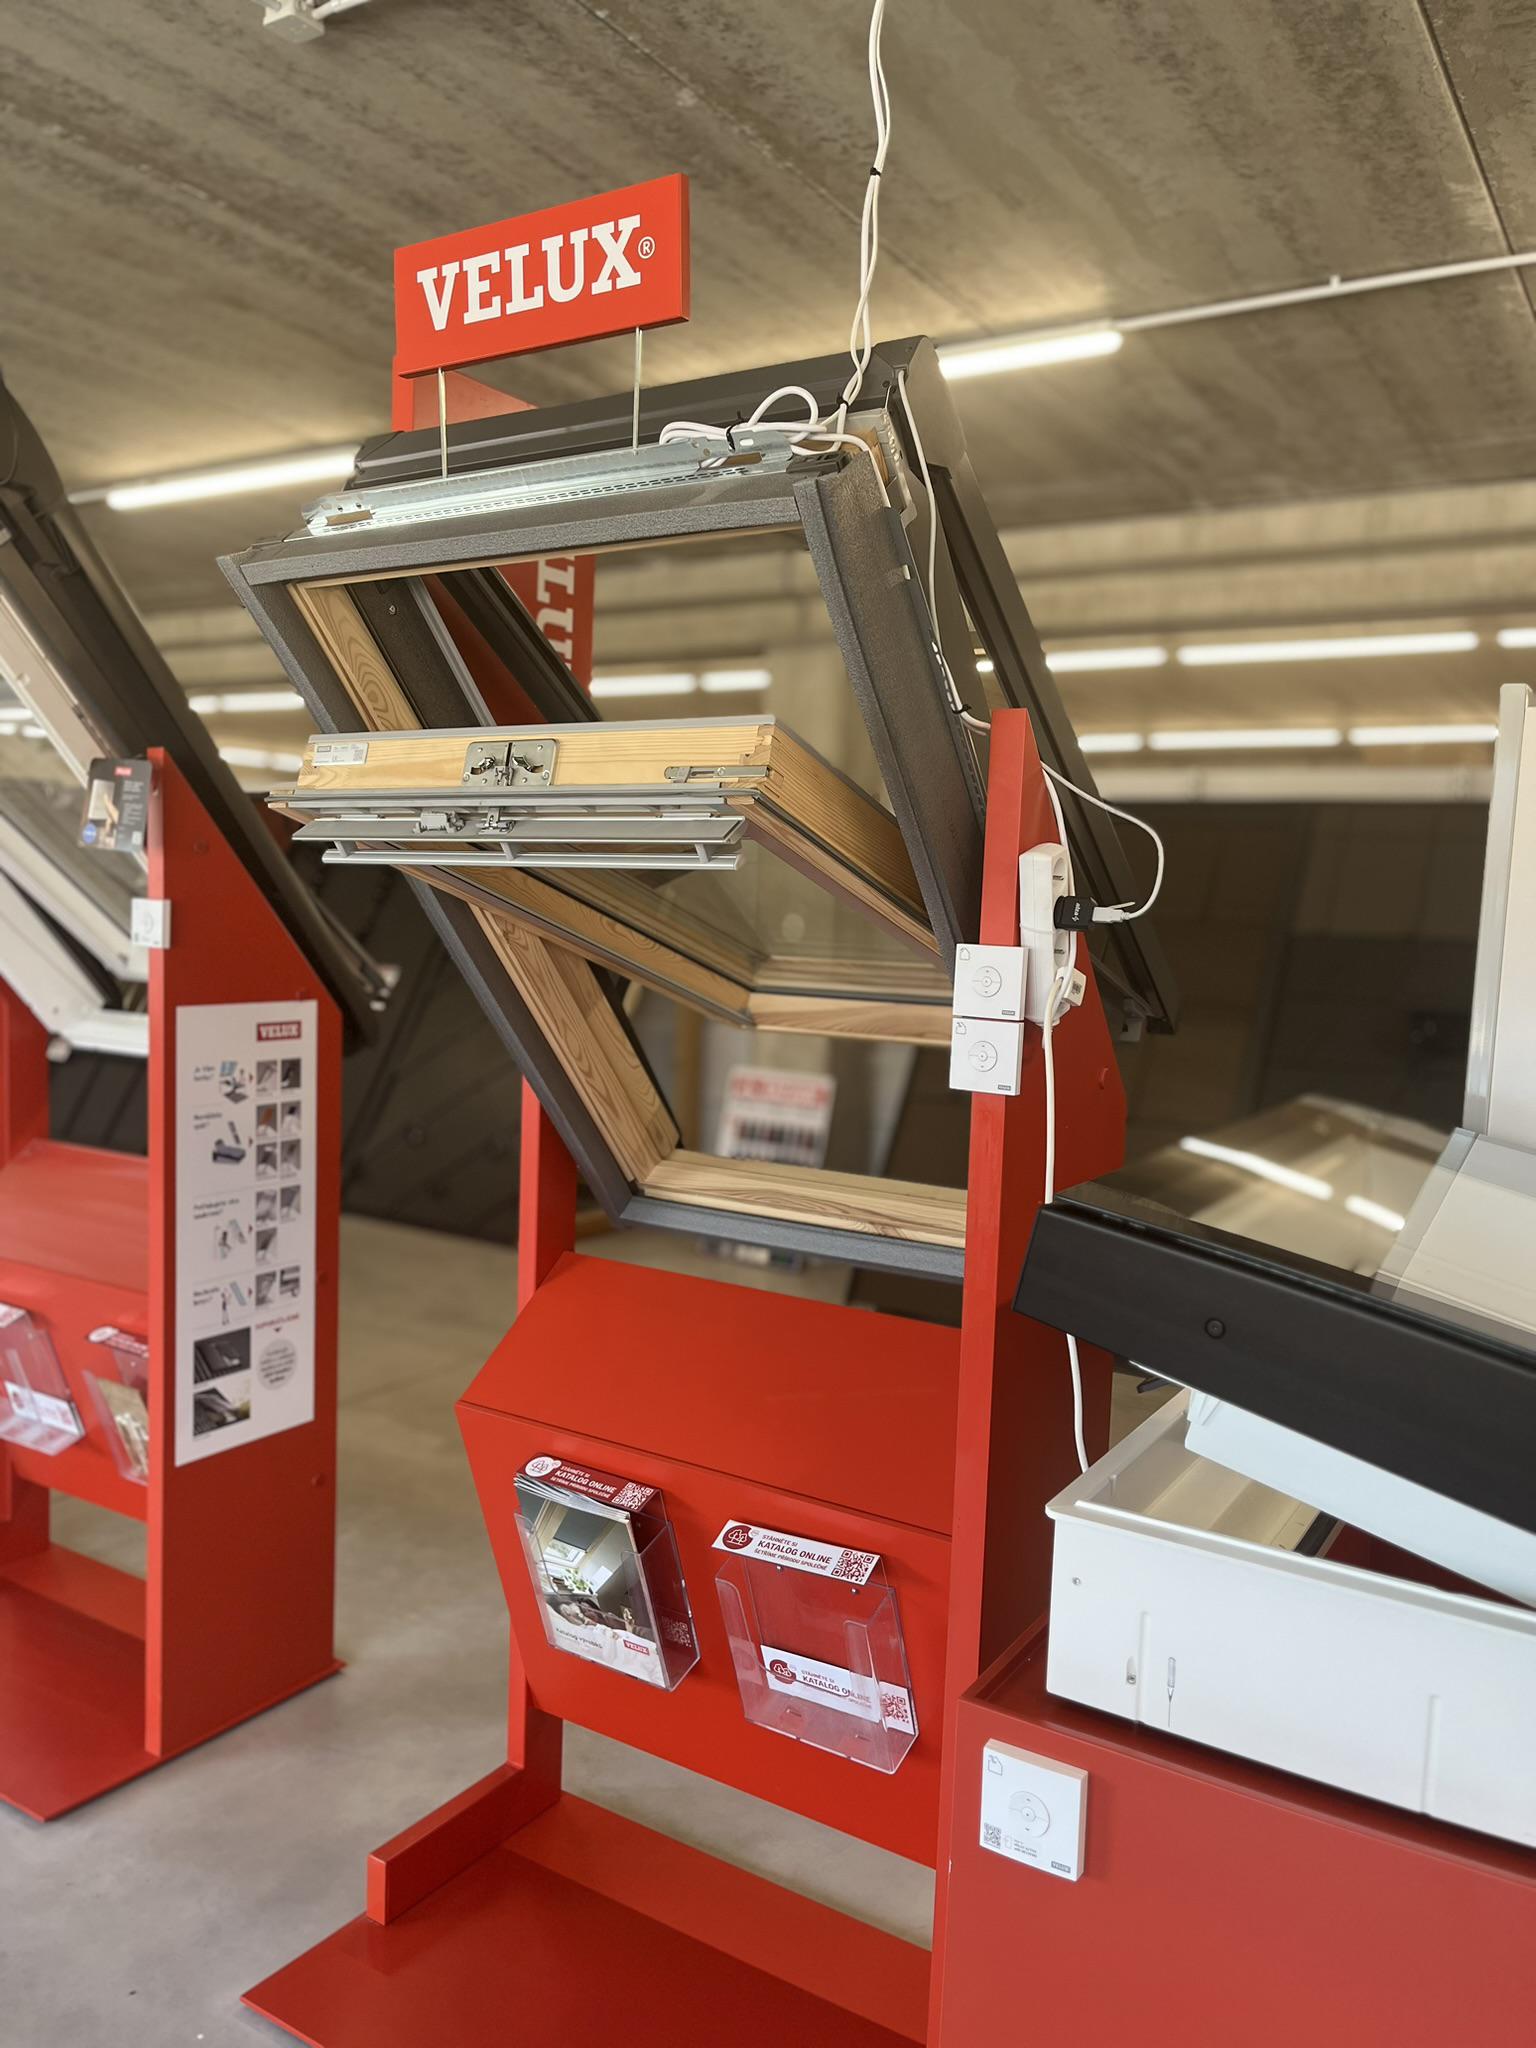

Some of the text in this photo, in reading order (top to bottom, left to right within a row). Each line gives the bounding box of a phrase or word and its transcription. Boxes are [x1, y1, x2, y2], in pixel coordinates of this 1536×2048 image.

[259, 1022, 299, 1039] VELUX
[555, 1470, 589, 1485] KATALOG
[588, 1480, 617, 1494] ONLINE
[762, 1534, 790, 1546] STÁHNĚTE
[757, 1540, 832, 1565] KATALOG ONLINE
[802, 1675, 840, 1693] KATALOG
